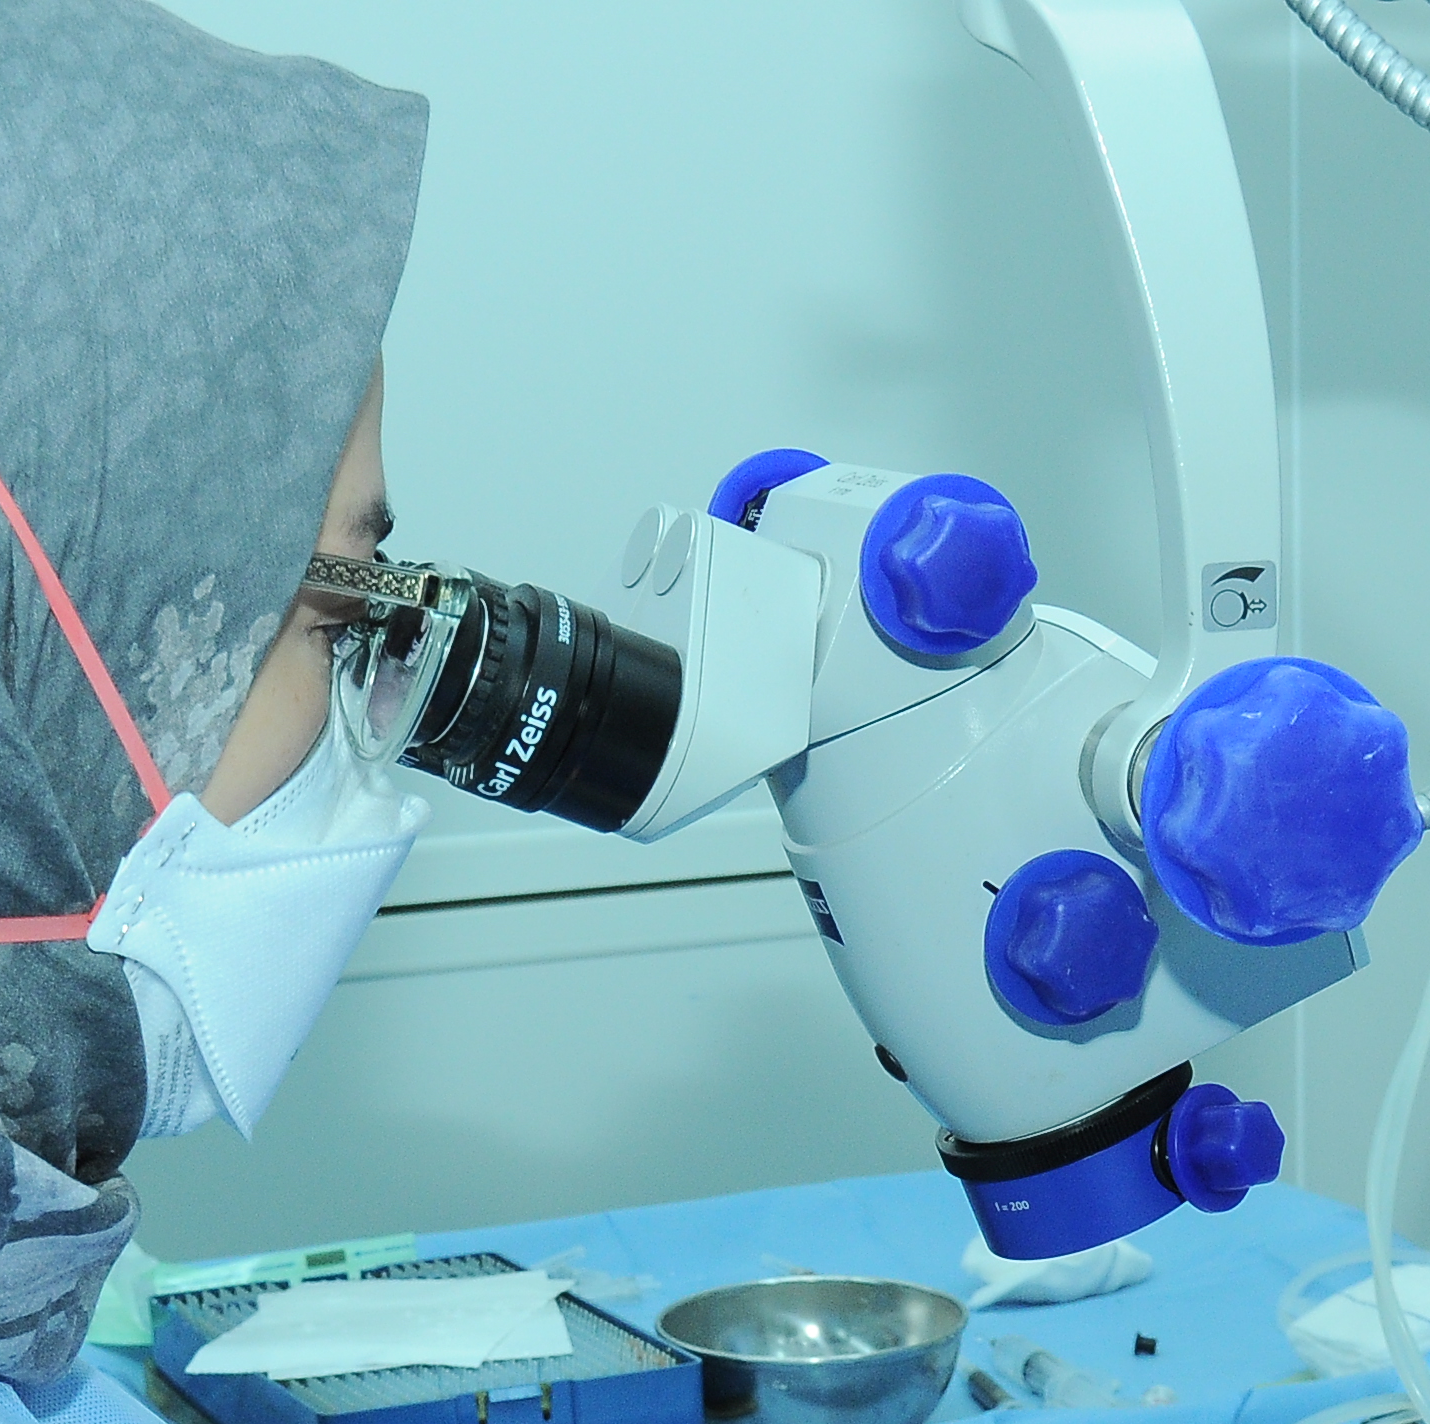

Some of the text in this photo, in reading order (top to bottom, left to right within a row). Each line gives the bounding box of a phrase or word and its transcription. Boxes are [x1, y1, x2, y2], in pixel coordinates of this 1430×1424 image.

[476, 686, 558, 799] Carl Zeiss
[1008, 1200, 1030, 1212] 200
